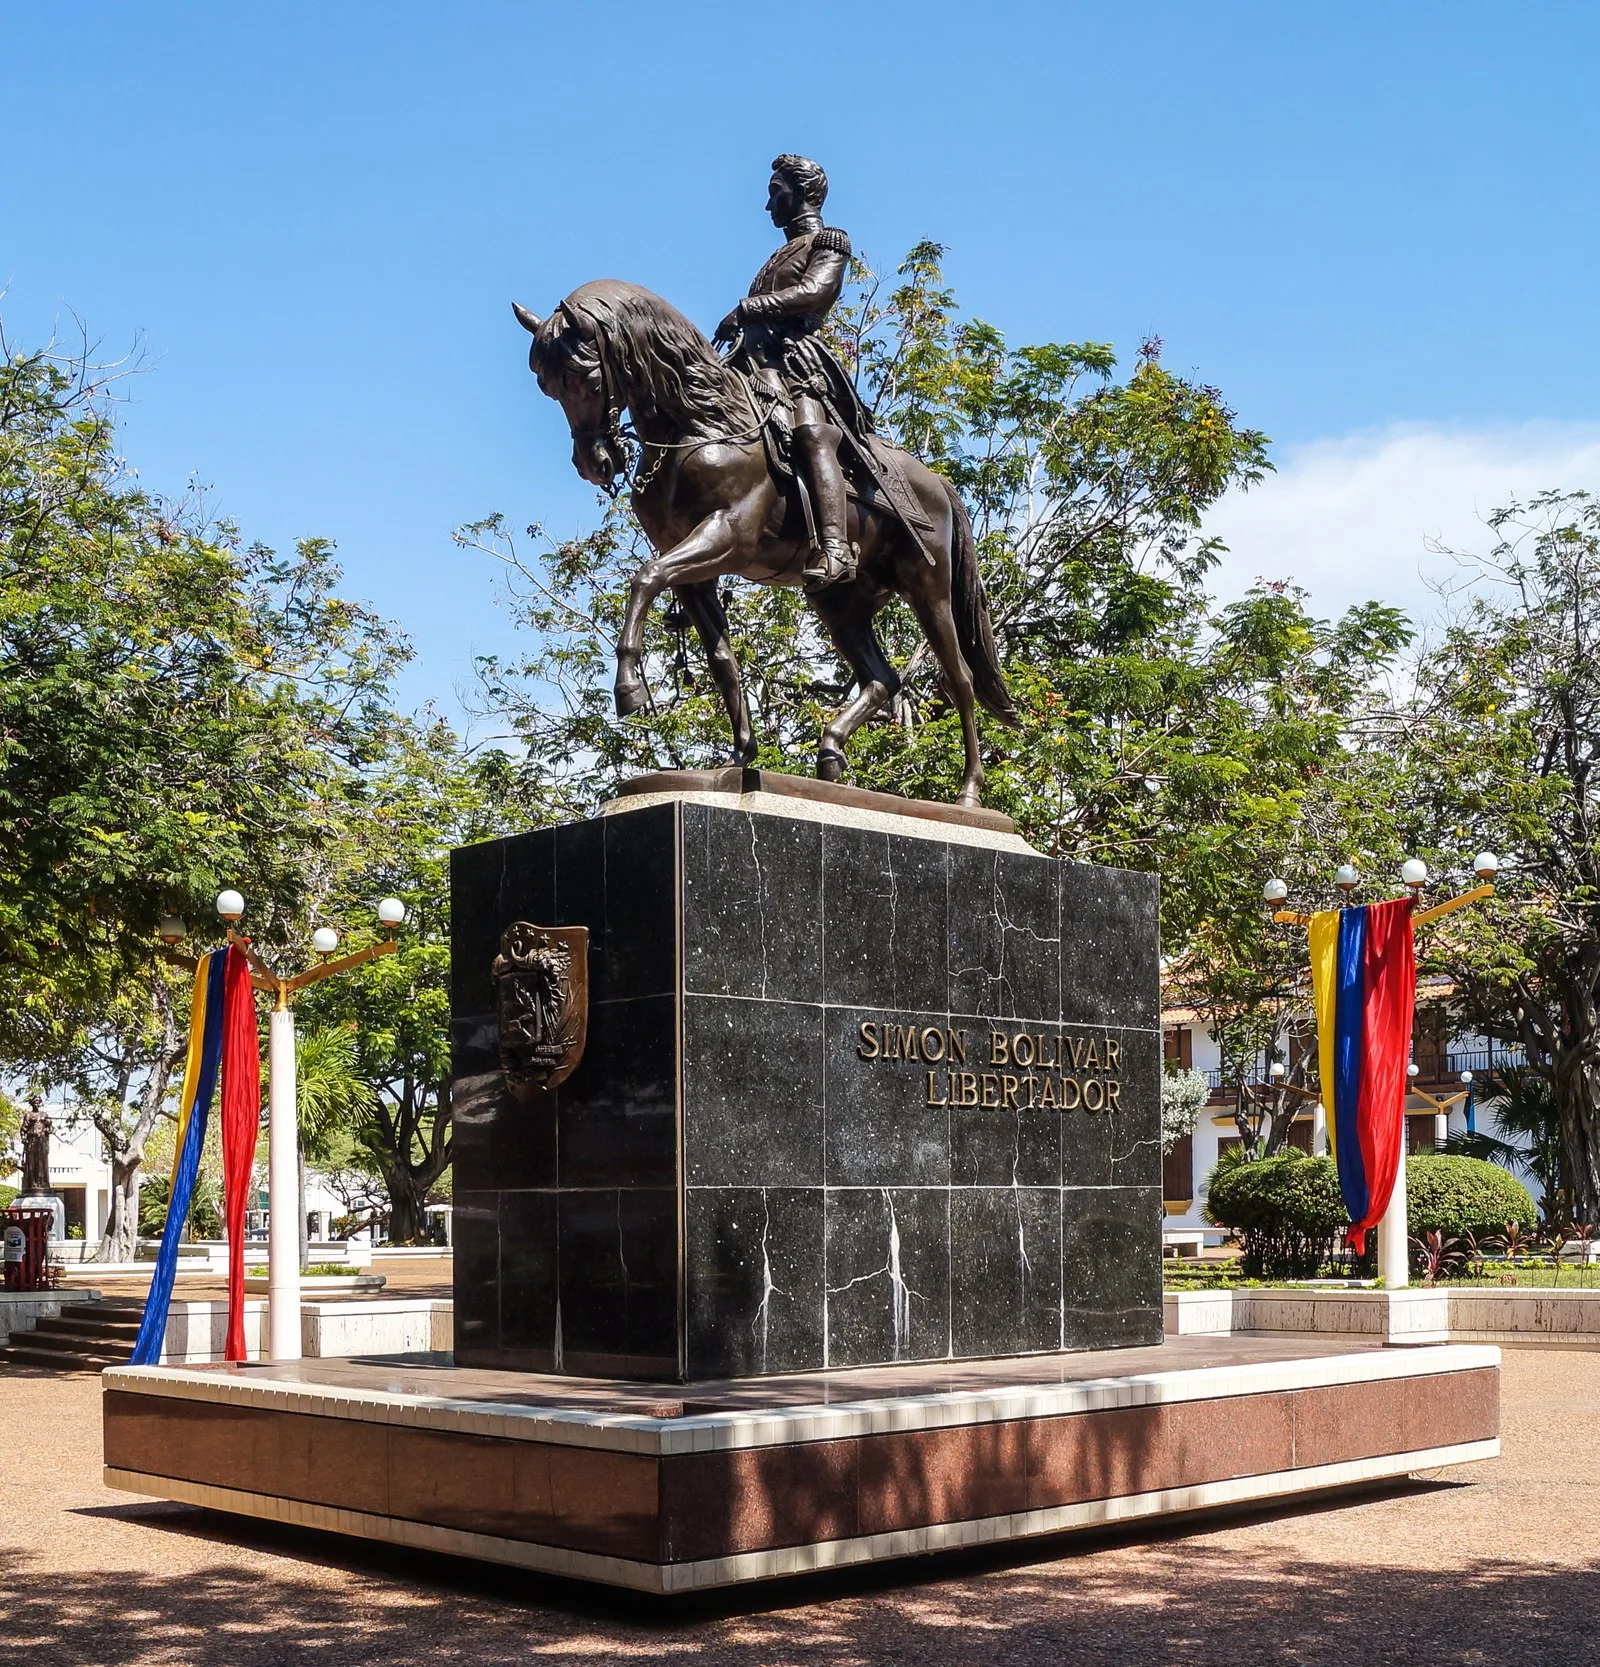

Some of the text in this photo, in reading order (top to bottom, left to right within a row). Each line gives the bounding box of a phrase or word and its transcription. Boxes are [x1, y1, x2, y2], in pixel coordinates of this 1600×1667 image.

[858, 1021, 1121, 1071] SIMON BOLIVAR
[927, 1070, 1121, 1111] LIBERTADOR
